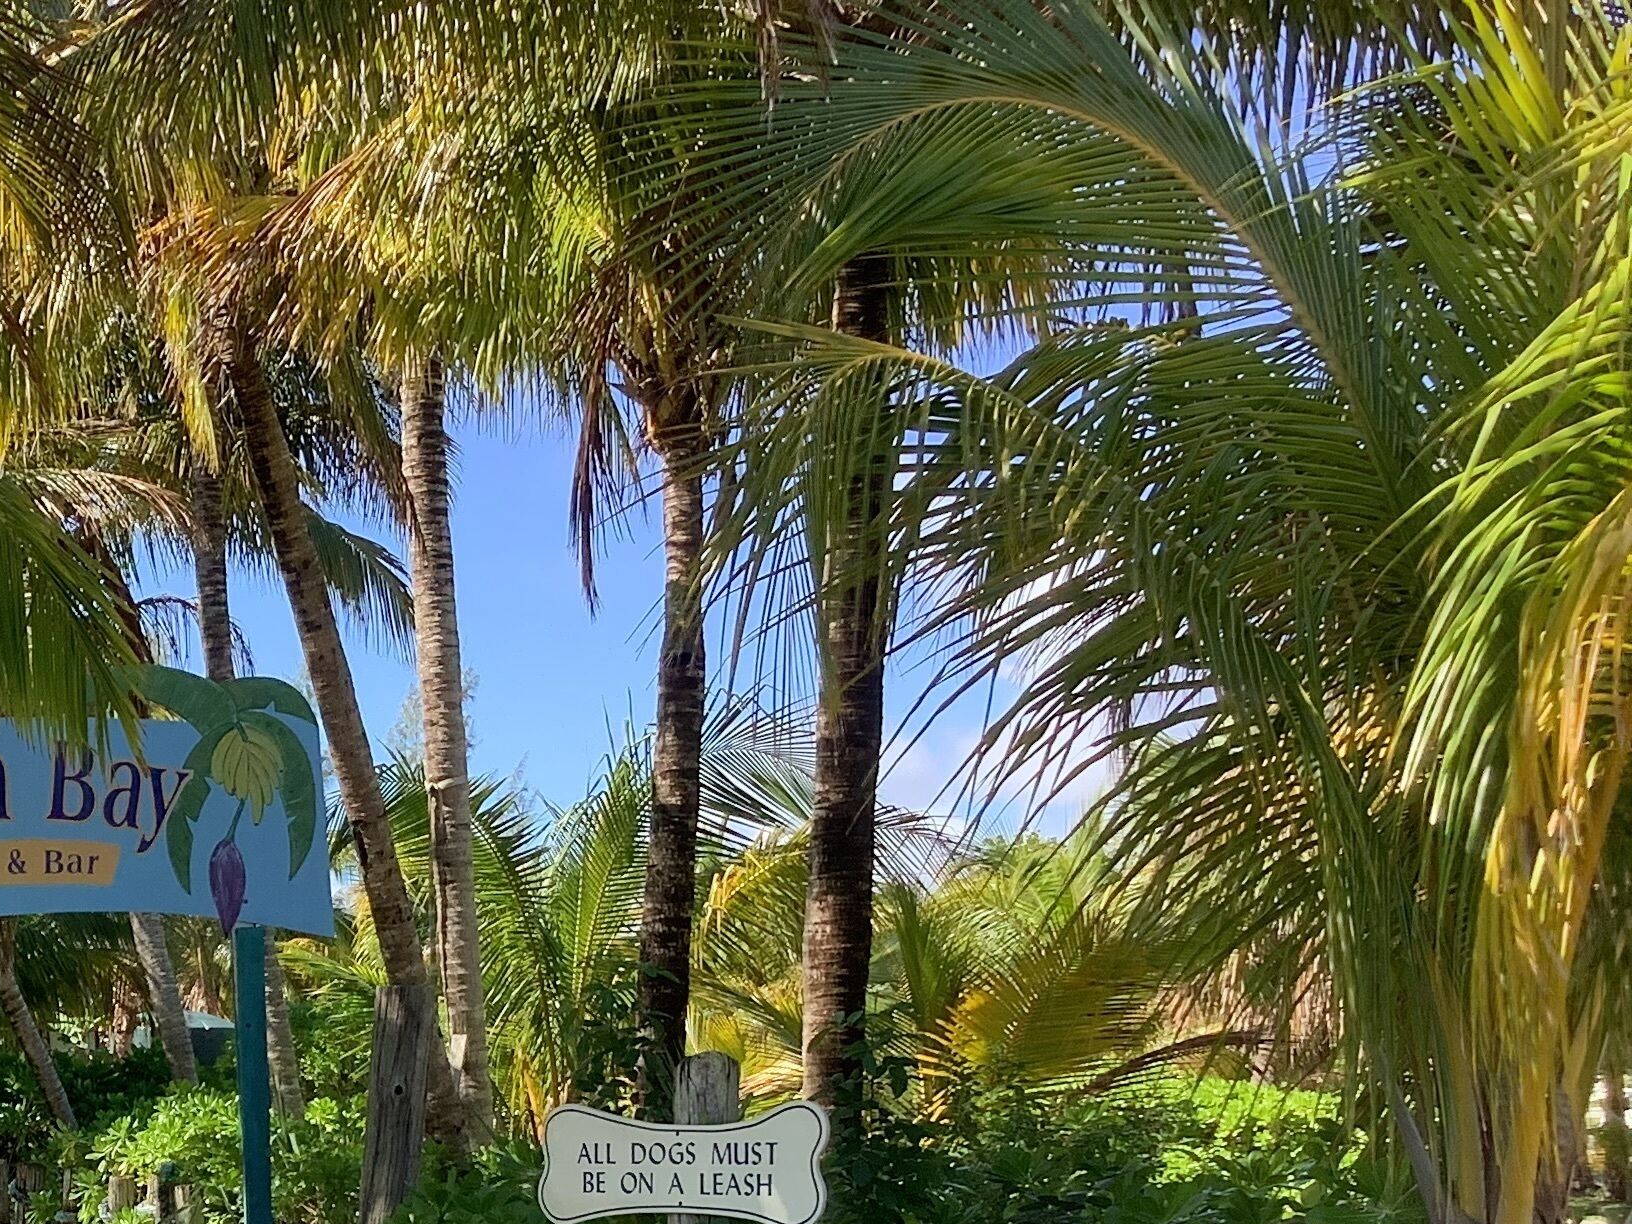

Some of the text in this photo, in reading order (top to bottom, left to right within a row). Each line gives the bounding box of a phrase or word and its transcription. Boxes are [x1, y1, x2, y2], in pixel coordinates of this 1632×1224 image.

[46, 741, 191, 853] Bay
[6, 849, 28, 874] &
[43, 850, 100, 878] Bar
[576, 1141, 779, 1166] ALL DOGS MUST
[581, 1171, 774, 1197] BE ON A LEASH
